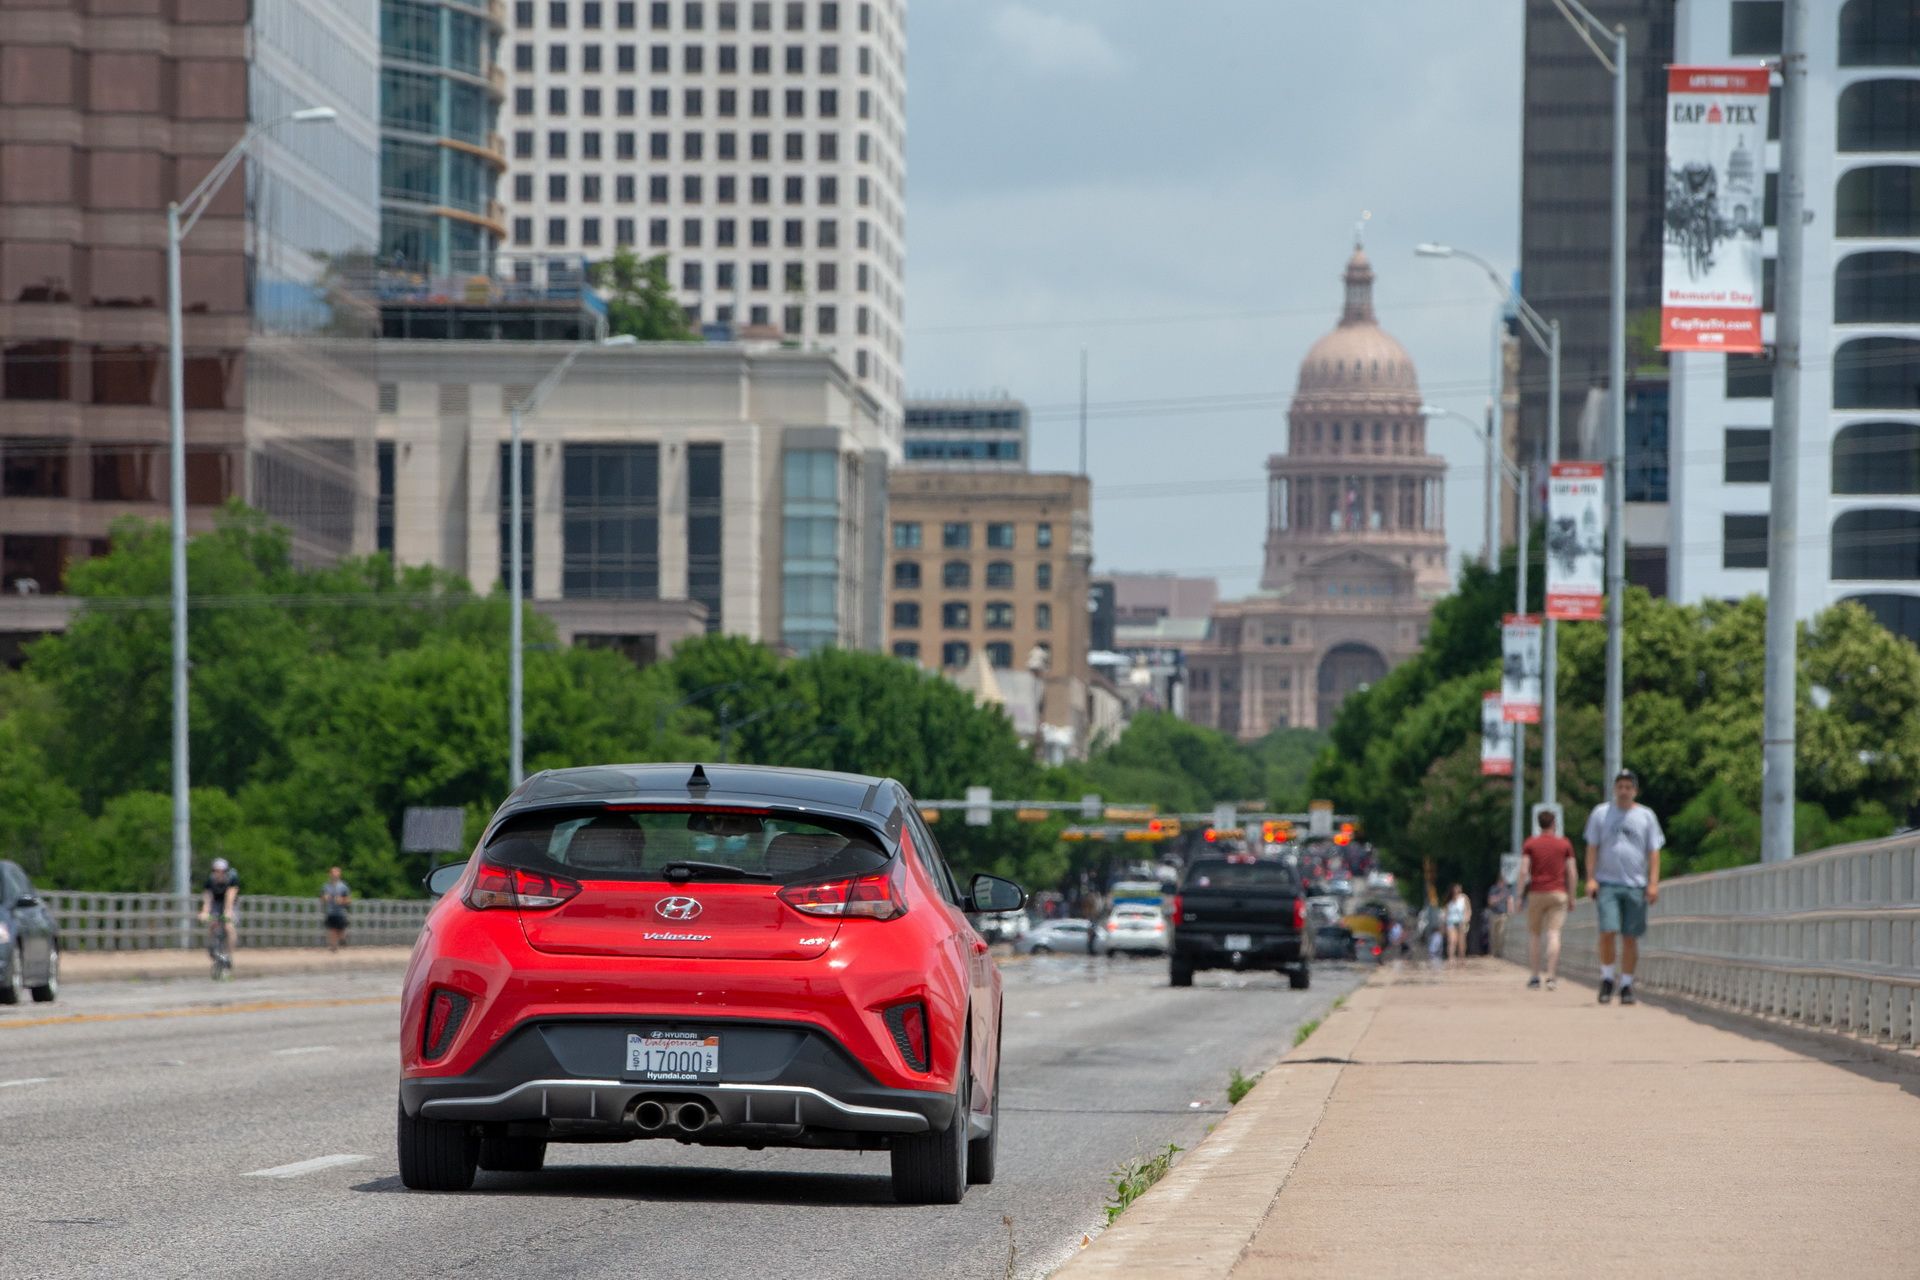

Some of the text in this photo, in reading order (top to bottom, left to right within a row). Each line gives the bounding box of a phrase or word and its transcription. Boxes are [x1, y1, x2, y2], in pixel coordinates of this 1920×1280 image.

[1673, 104, 1757, 124] CAP TEX
[1730, 291, 1753, 303] Day
[643, 932, 711, 941] Veloster
[644, 1050, 702, 1072] 17000
[647, 1072, 698, 1080] Hyundai.com
